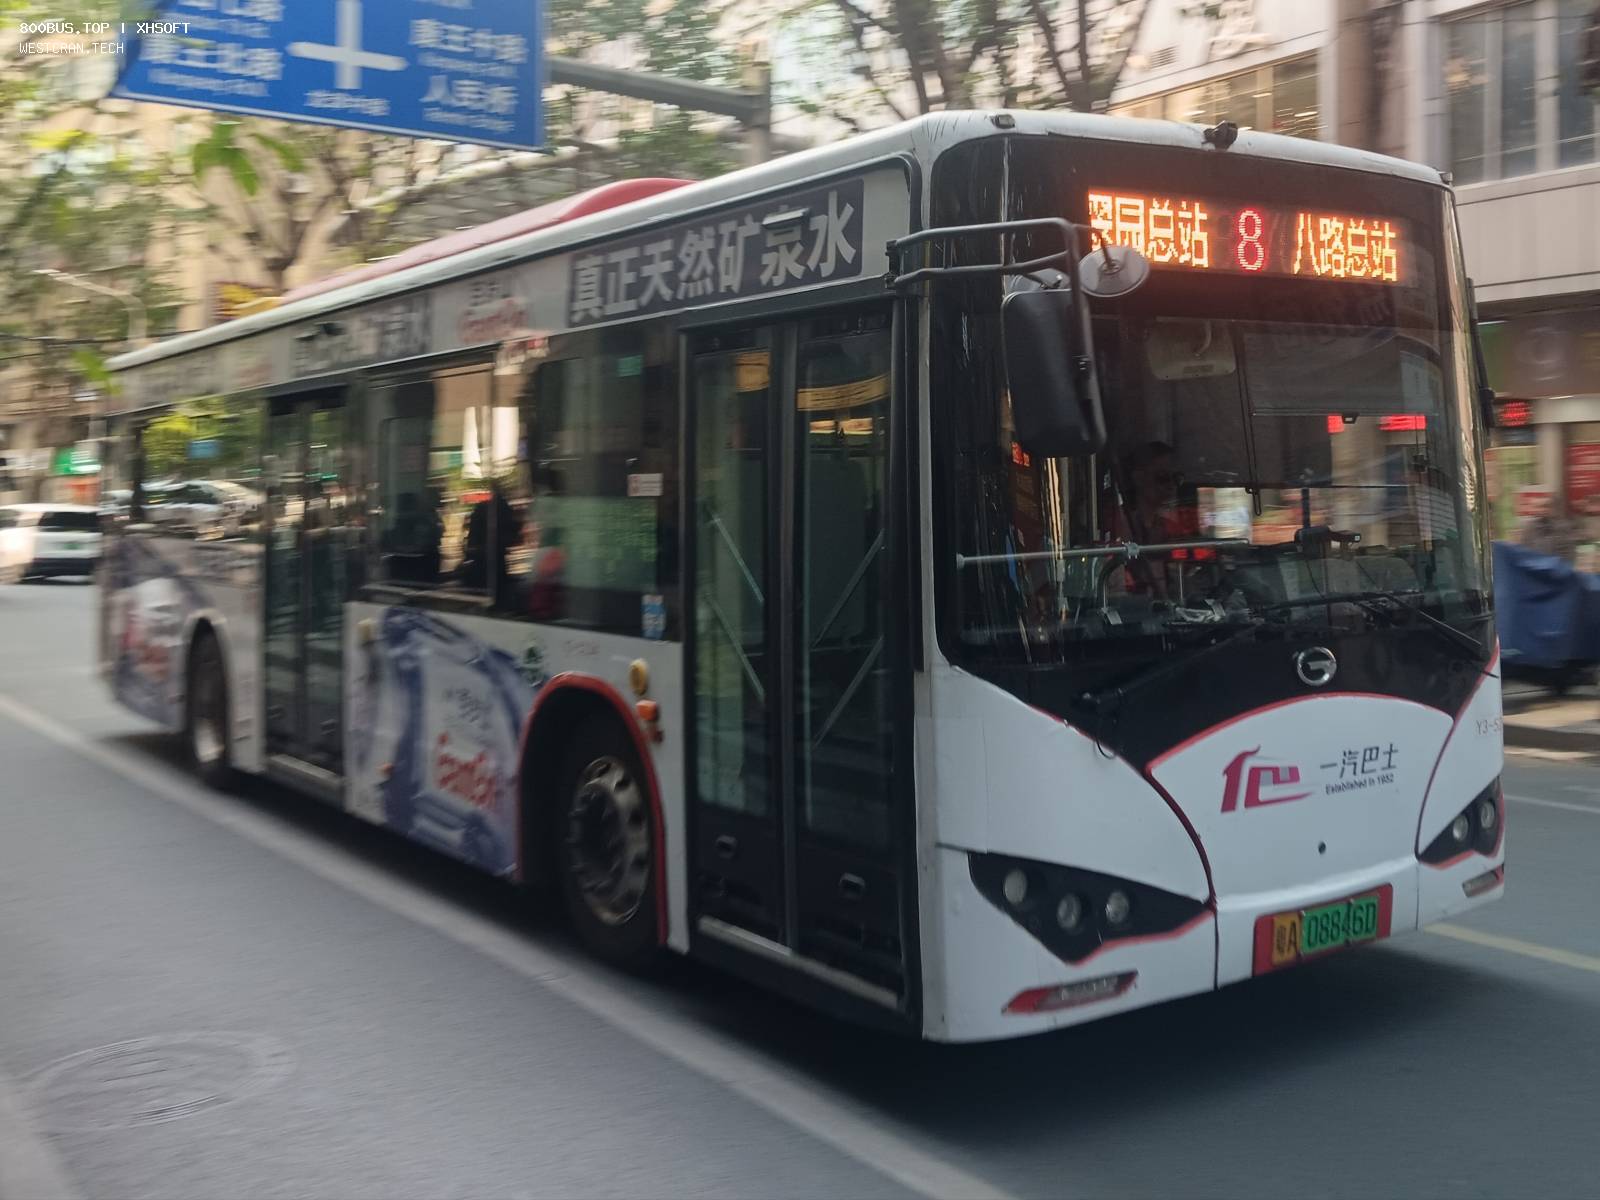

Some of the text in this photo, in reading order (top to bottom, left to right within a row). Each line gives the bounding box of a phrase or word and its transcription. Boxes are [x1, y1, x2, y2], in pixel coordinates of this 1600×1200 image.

[572, 189, 858, 323] 真正天然矿泉水
[1236, 209, 1265, 271] 8
[1293, 213, 1398, 282] 八路总站
[1319, 743, 1399, 779] 一汽巴士
